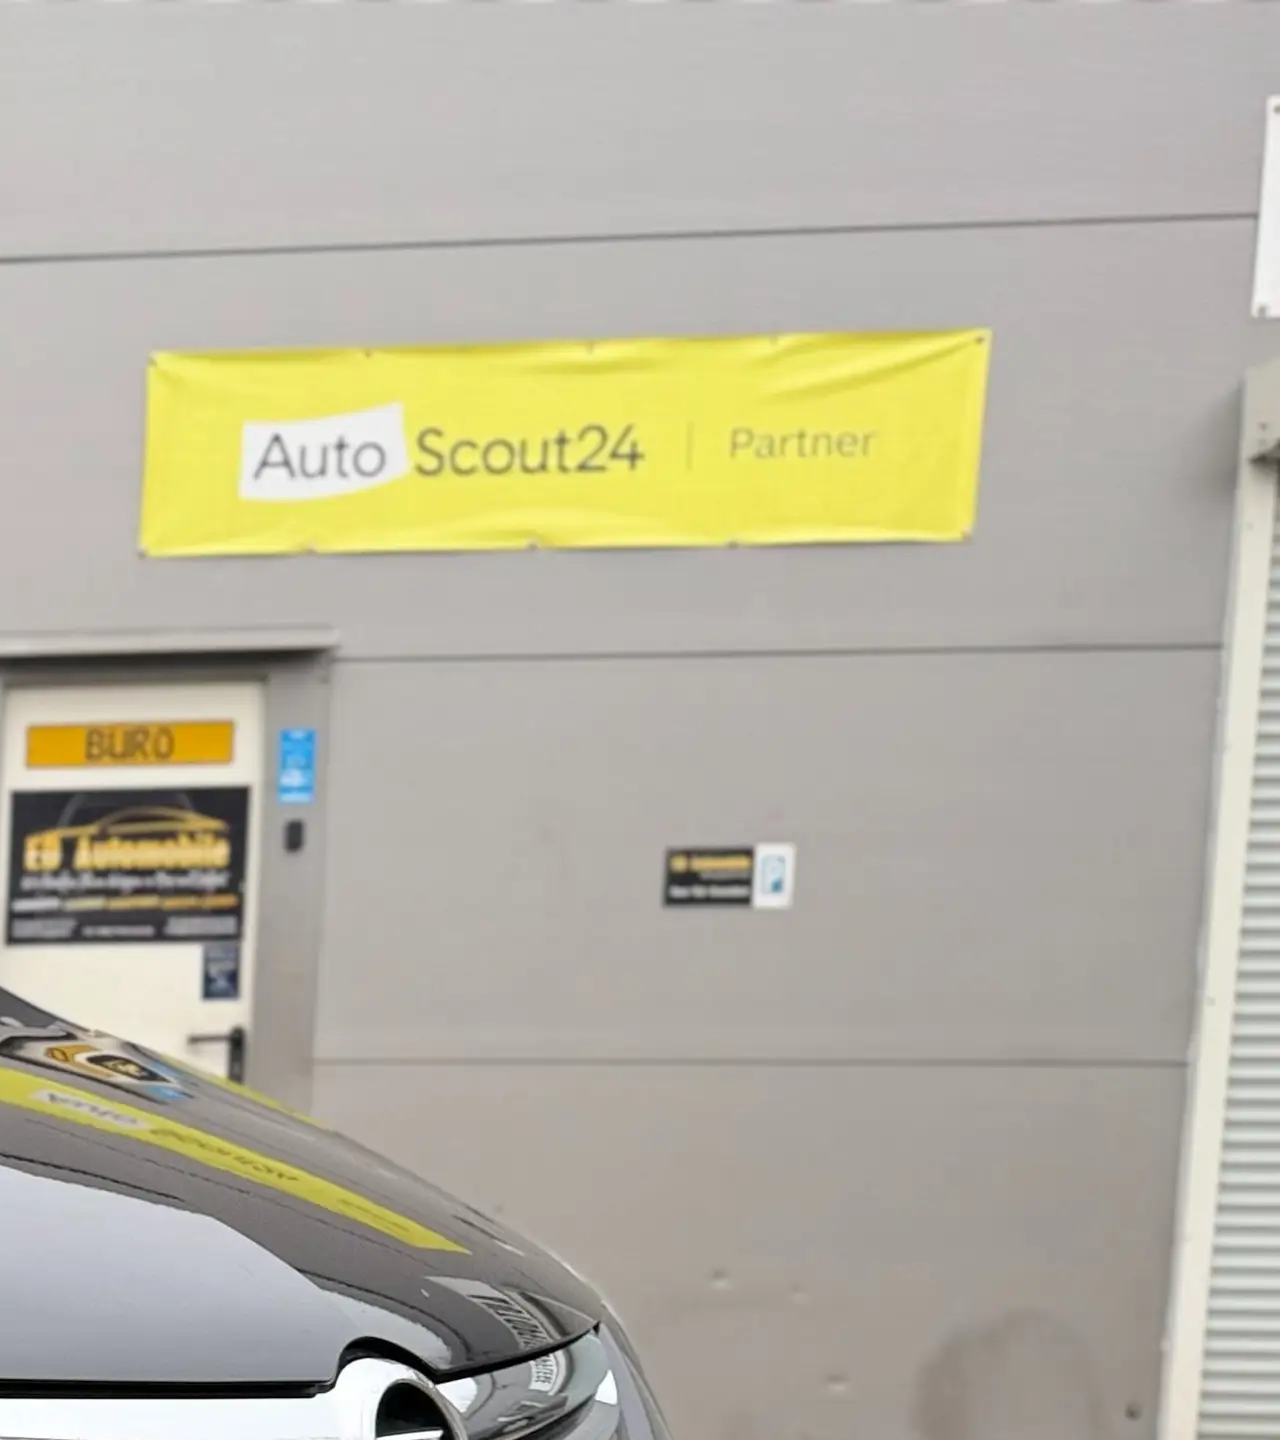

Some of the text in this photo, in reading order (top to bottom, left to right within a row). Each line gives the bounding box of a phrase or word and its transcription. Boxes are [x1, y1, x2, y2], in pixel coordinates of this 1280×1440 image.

[253, 423, 876, 481] Auto Scout24 Partner
